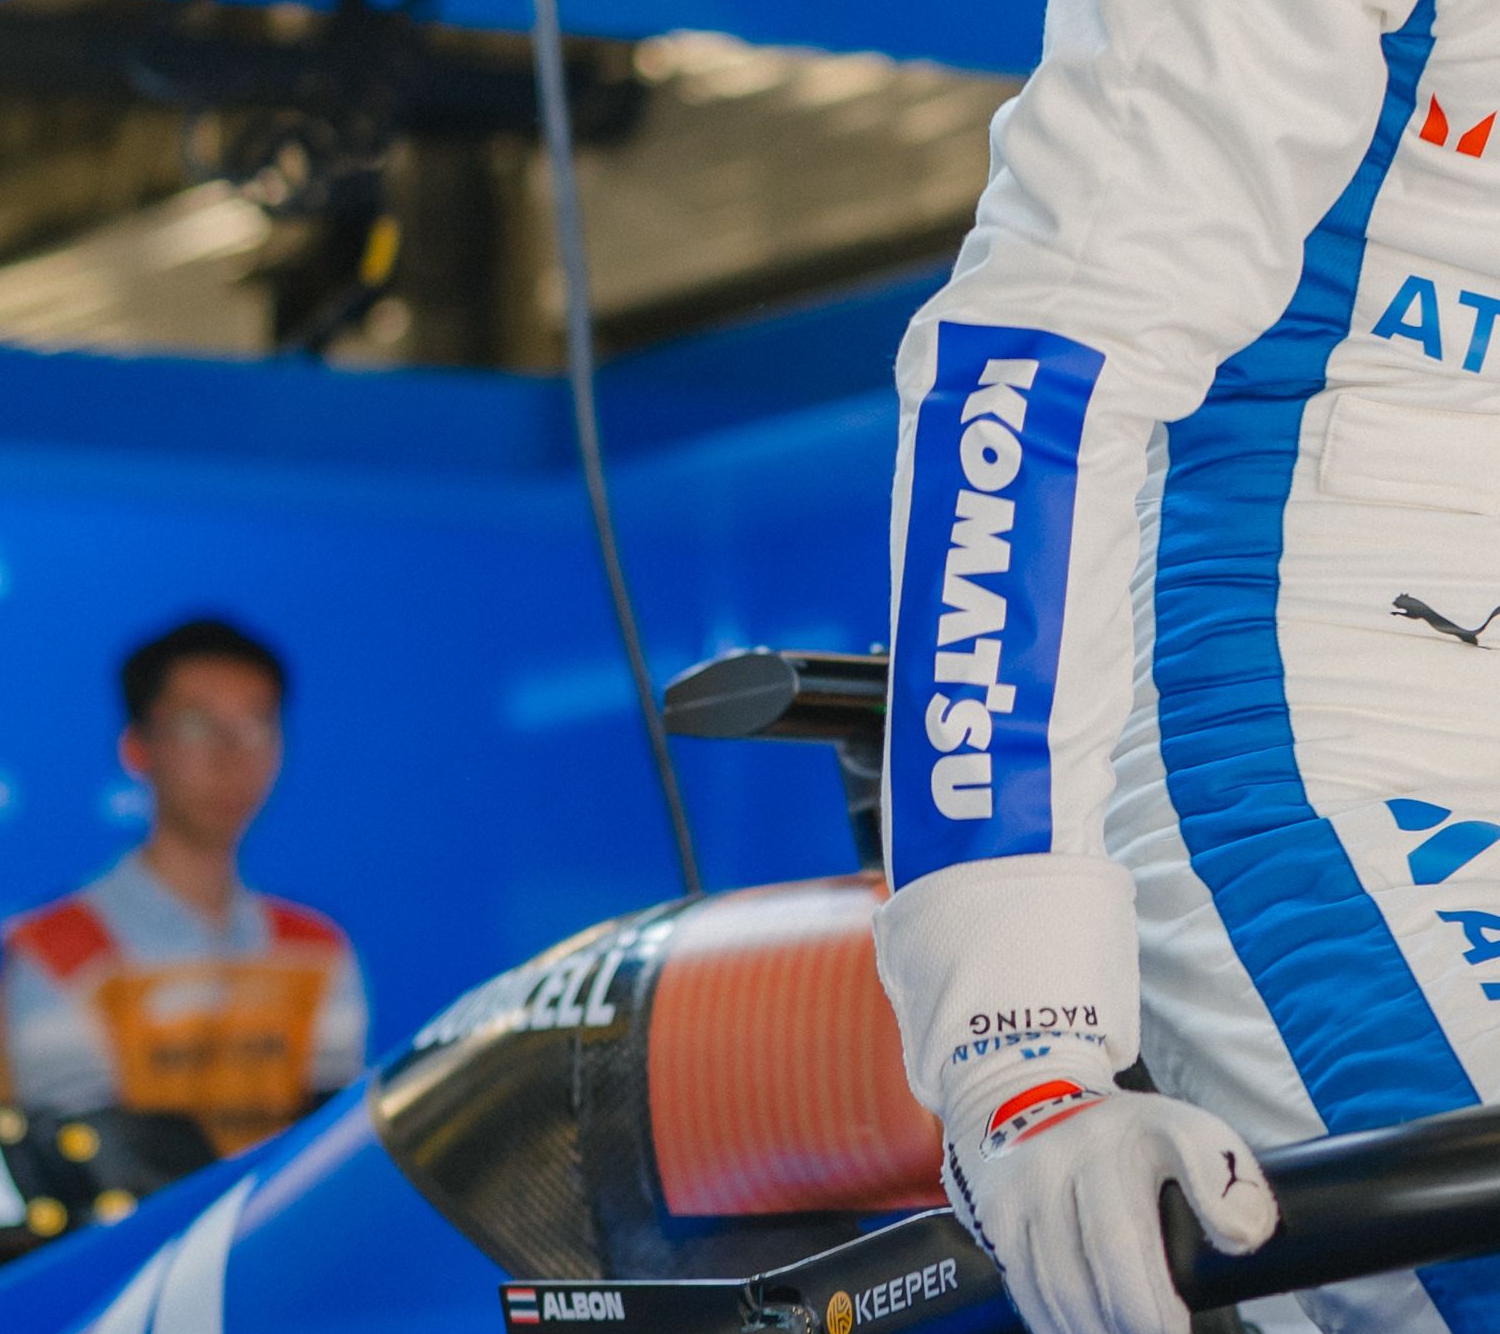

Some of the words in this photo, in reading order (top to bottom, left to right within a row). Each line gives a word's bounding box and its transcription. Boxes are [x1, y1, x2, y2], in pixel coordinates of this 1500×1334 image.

[924, 356, 1041, 823] KOMATSU
[969, 1005, 1099, 1036] RACING
[542, 1291, 626, 1322] ALBON
[853, 1257, 959, 1326] KEEPER
